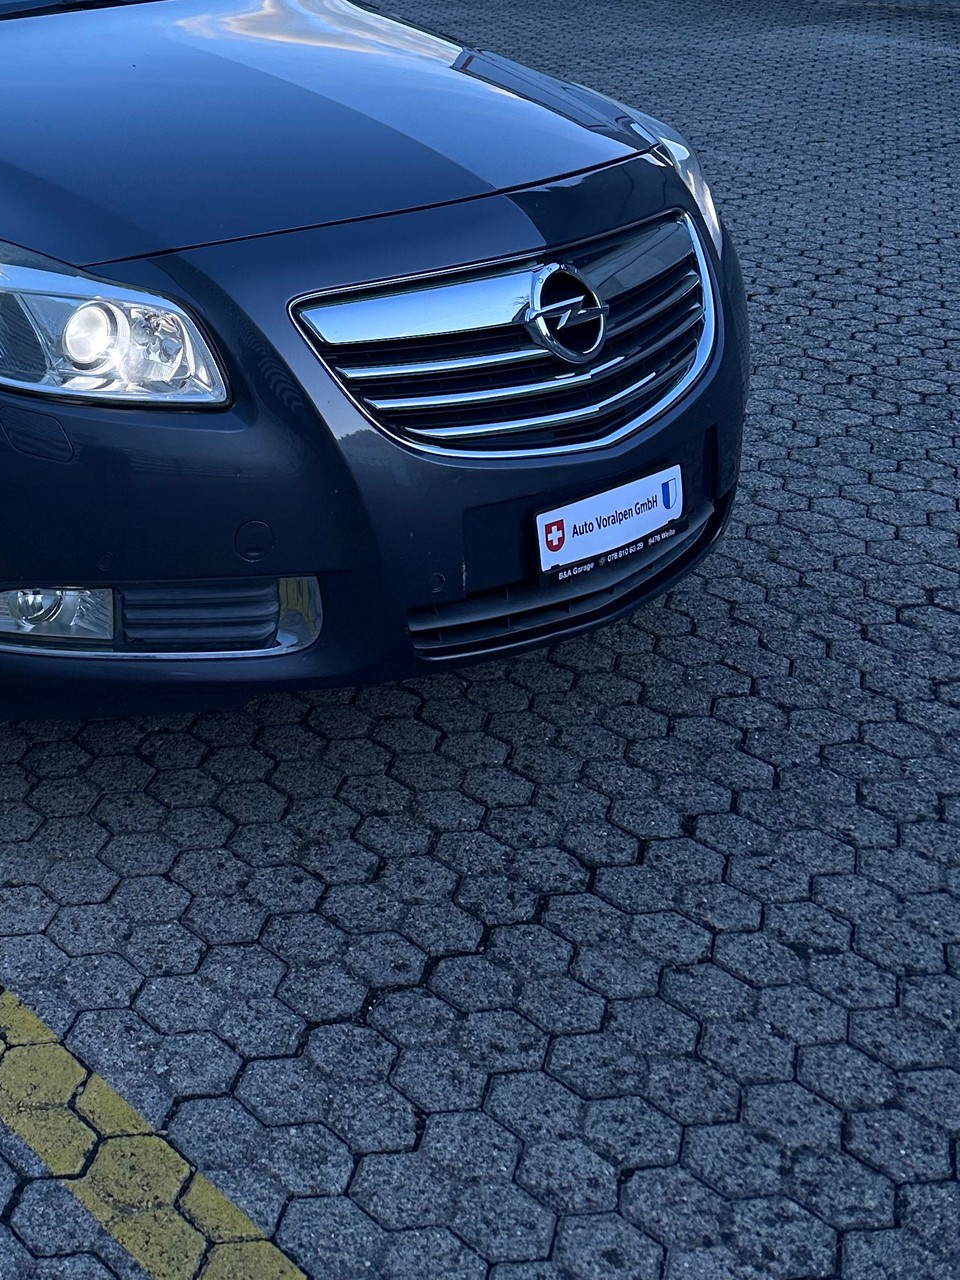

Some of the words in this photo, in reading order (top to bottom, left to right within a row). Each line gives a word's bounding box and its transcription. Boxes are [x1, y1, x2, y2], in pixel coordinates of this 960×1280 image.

[572, 521, 594, 538] Auto
[596, 507, 633, 529] Voralpen
[634, 494, 658, 515] GmbH
[572, 562, 594, 574] Garage
